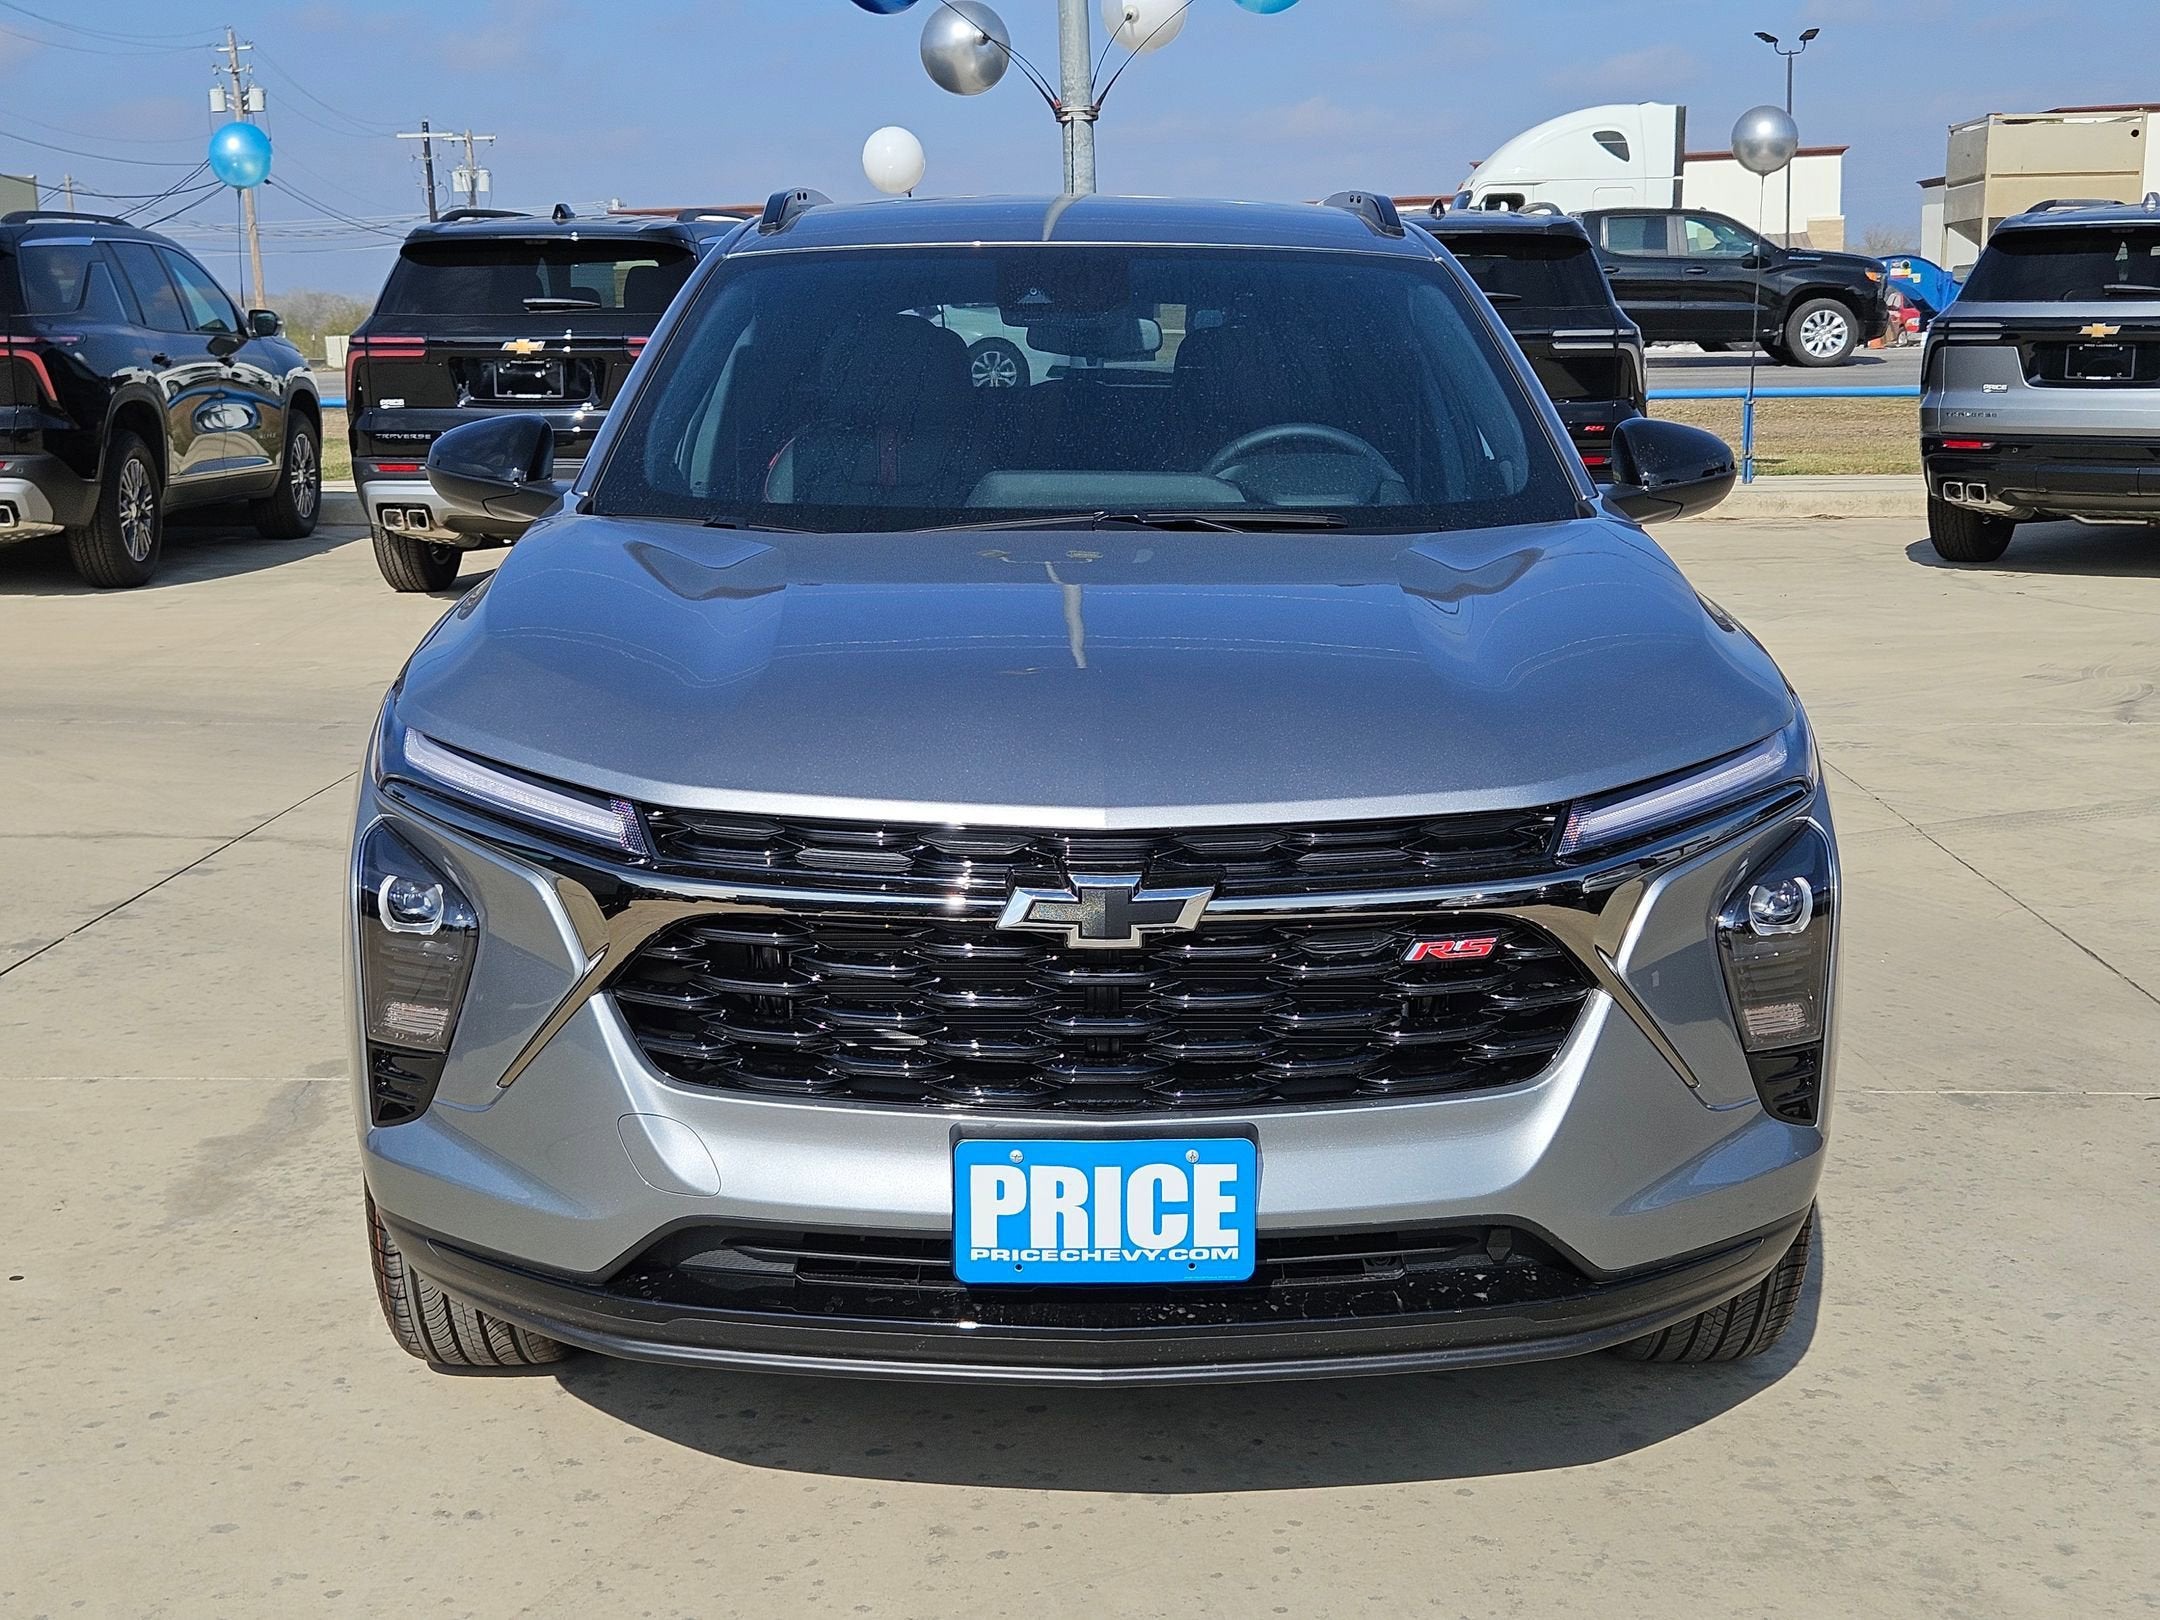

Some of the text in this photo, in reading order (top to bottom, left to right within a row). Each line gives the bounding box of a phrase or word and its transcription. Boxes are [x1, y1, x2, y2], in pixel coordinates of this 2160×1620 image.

[1983, 383, 2008, 391] PRICE
[1404, 937, 1499, 961] RS
[970, 1163, 1239, 1250] PRICE
[970, 1247, 1239, 1262] PRICECHEVY.COM
